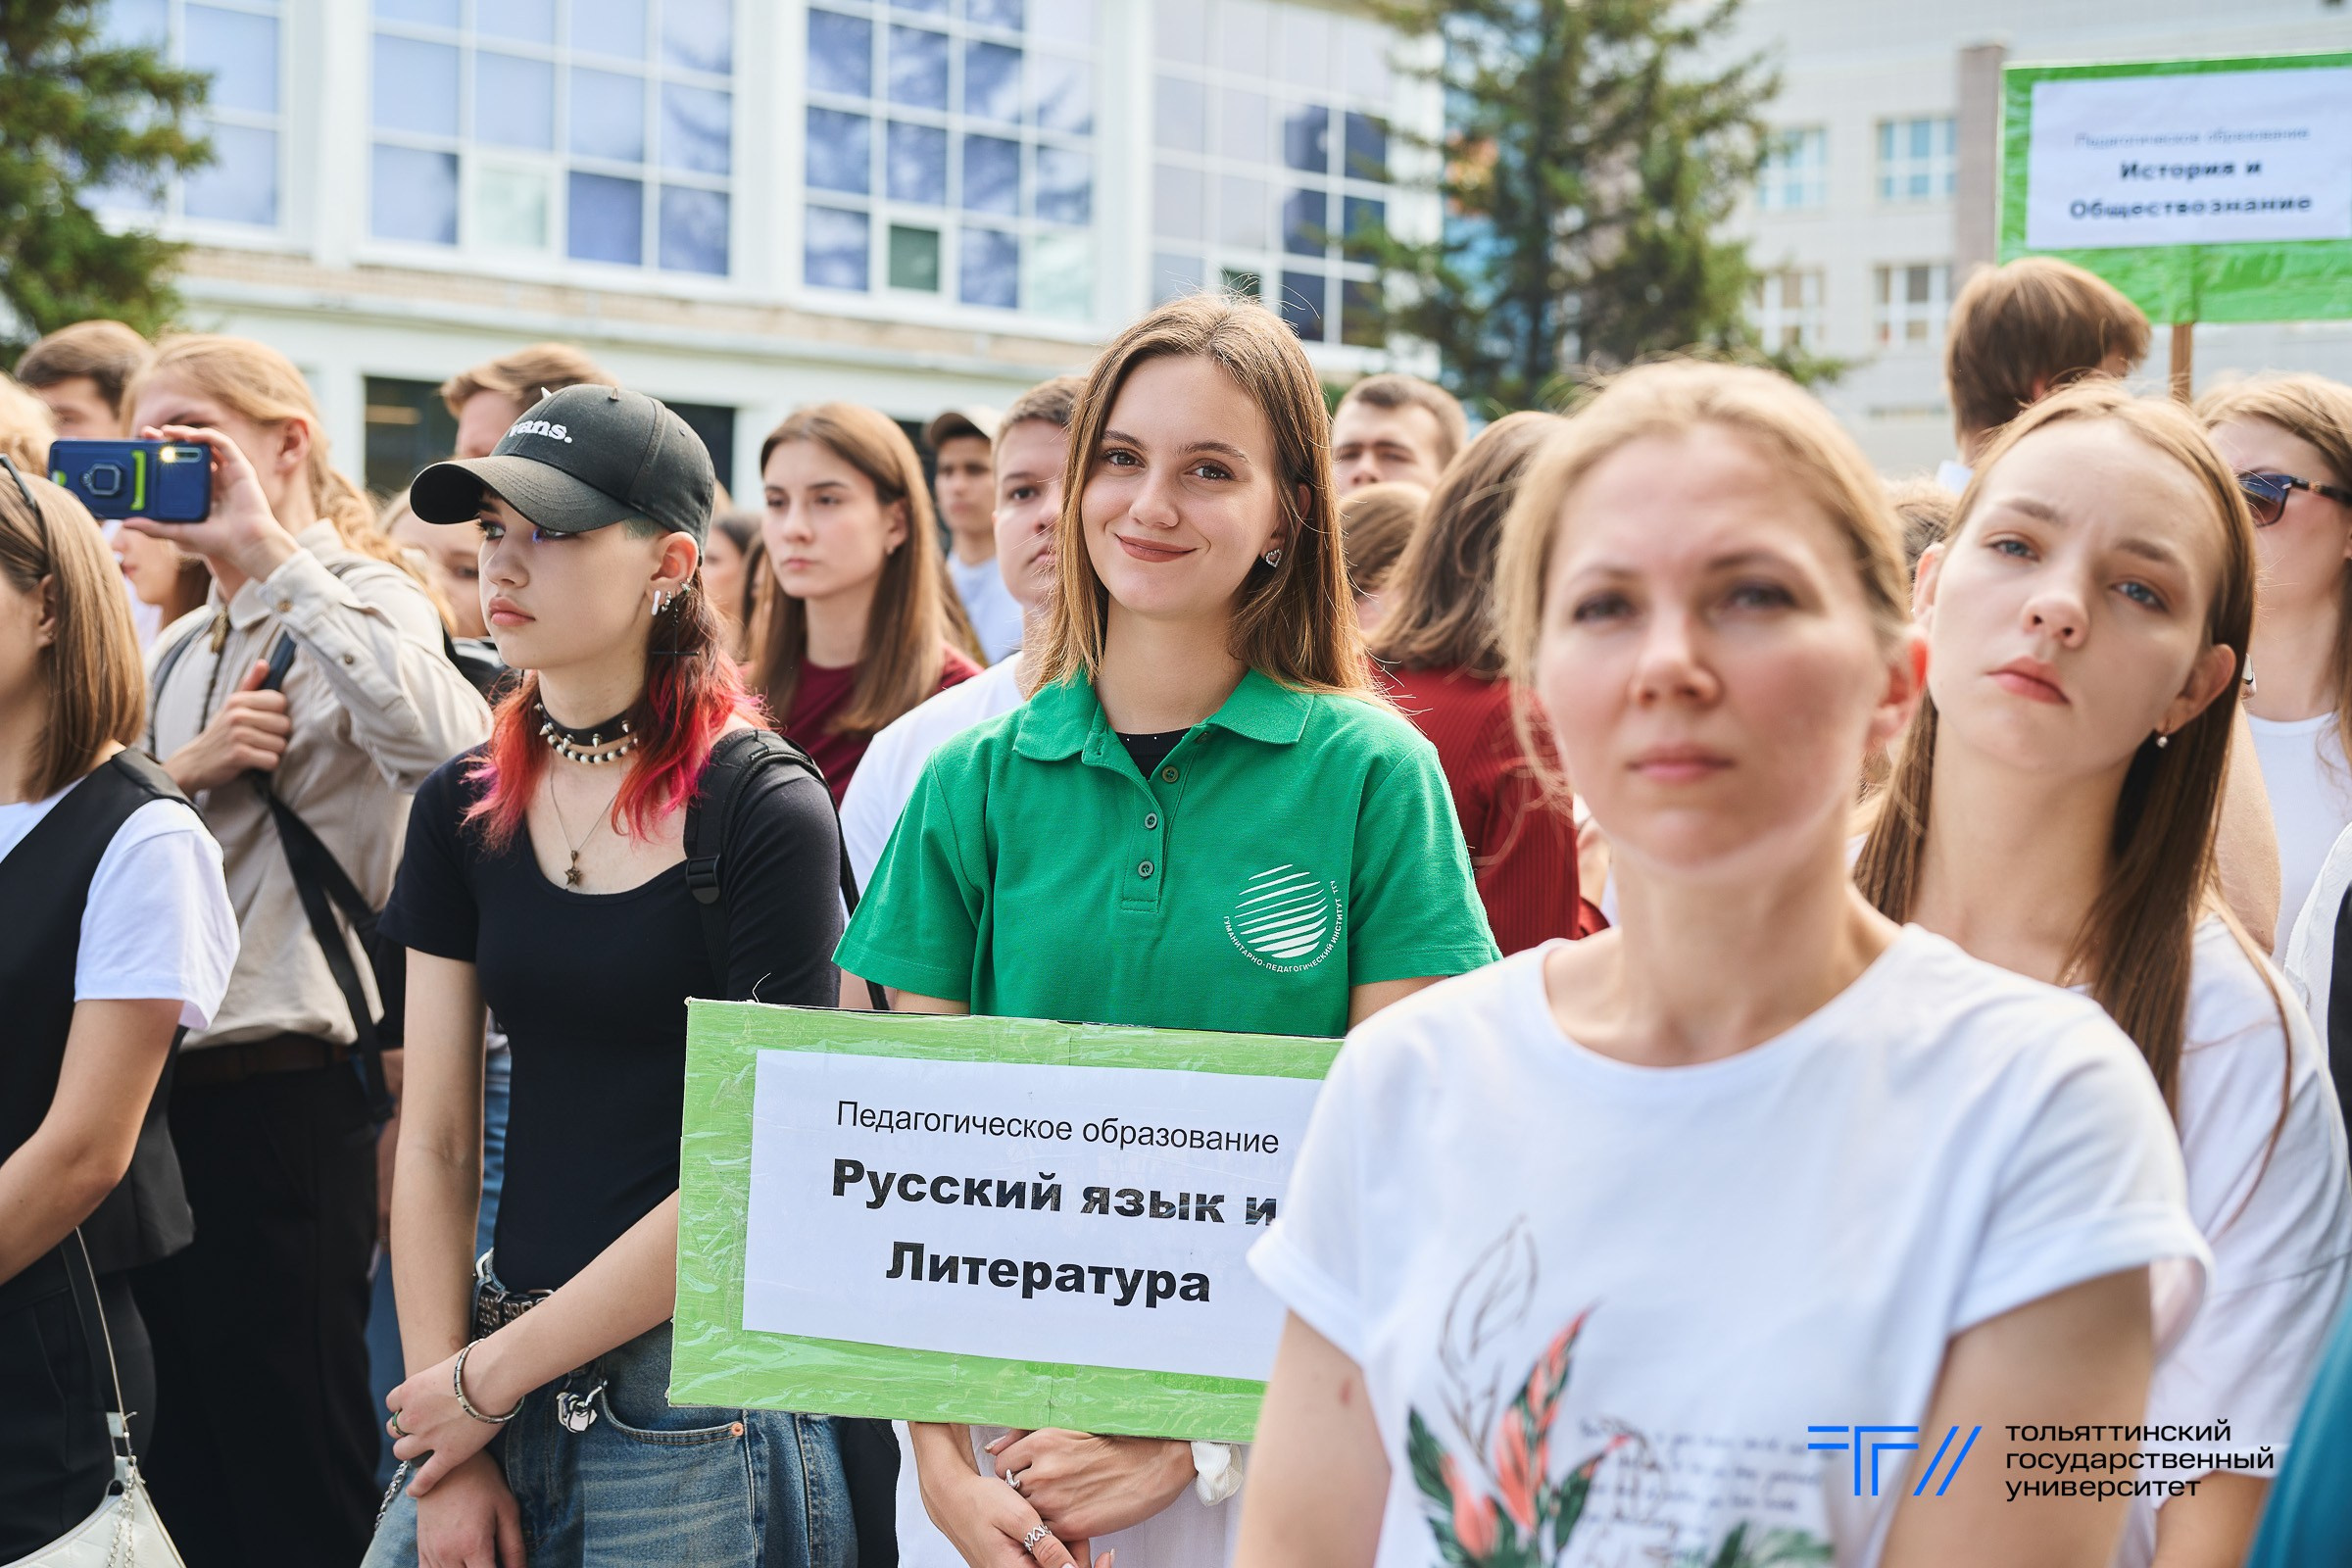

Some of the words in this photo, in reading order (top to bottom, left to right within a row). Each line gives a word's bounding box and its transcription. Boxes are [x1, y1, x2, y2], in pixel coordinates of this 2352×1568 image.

[2120, 161, 2236, 183] История
[2245, 161, 2263, 174] и
[2070, 196, 2312, 220] Обществознание
[1223, 915, 1334, 973] ГУМАНИТАРНО-ПЕДАГОГИЧЕСКИЙ
[1331, 898, 1344, 944] ИНСТИТУТ
[837, 1100, 1073, 1141] Педагогическое
[1082, 1117, 1279, 1154] образование
[832, 1157, 1062, 1212] Русский
[1080, 1186, 1225, 1223] язык
[1245, 1197, 1277, 1226] и
[885, 1241, 1210, 1309] Литература
